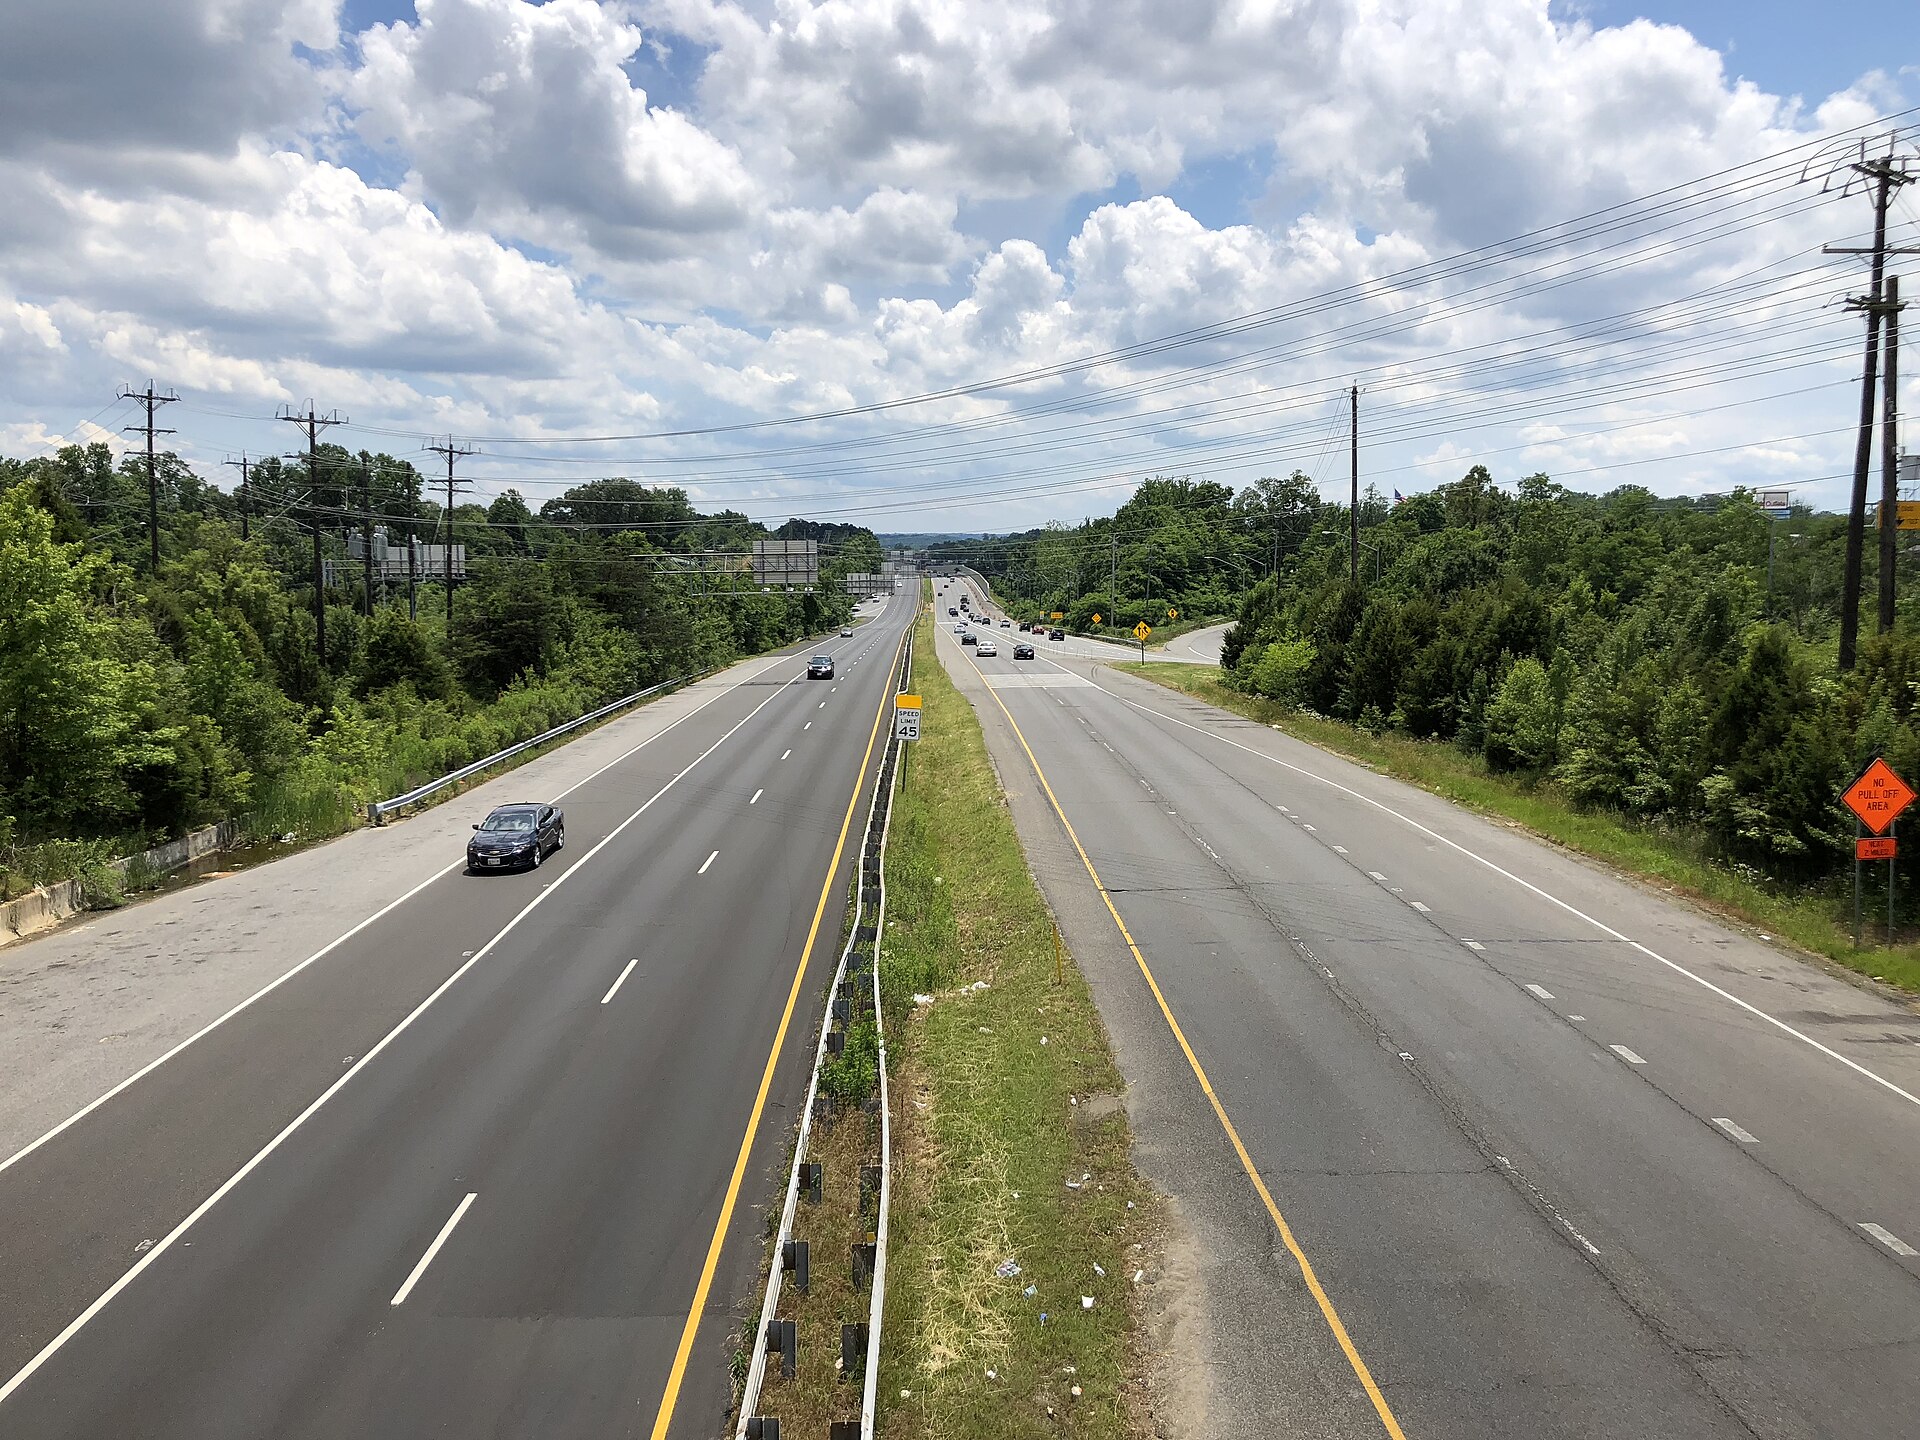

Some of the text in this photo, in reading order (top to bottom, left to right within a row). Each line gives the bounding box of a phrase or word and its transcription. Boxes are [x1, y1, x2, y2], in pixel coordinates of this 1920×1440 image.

[898, 726, 917, 737] 45
[1872, 778, 1884, 787] NO
[1858, 789, 1899, 799] PULL OFF
[1866, 801, 1889, 811] AREA
[1864, 849, 1869, 857] 2
